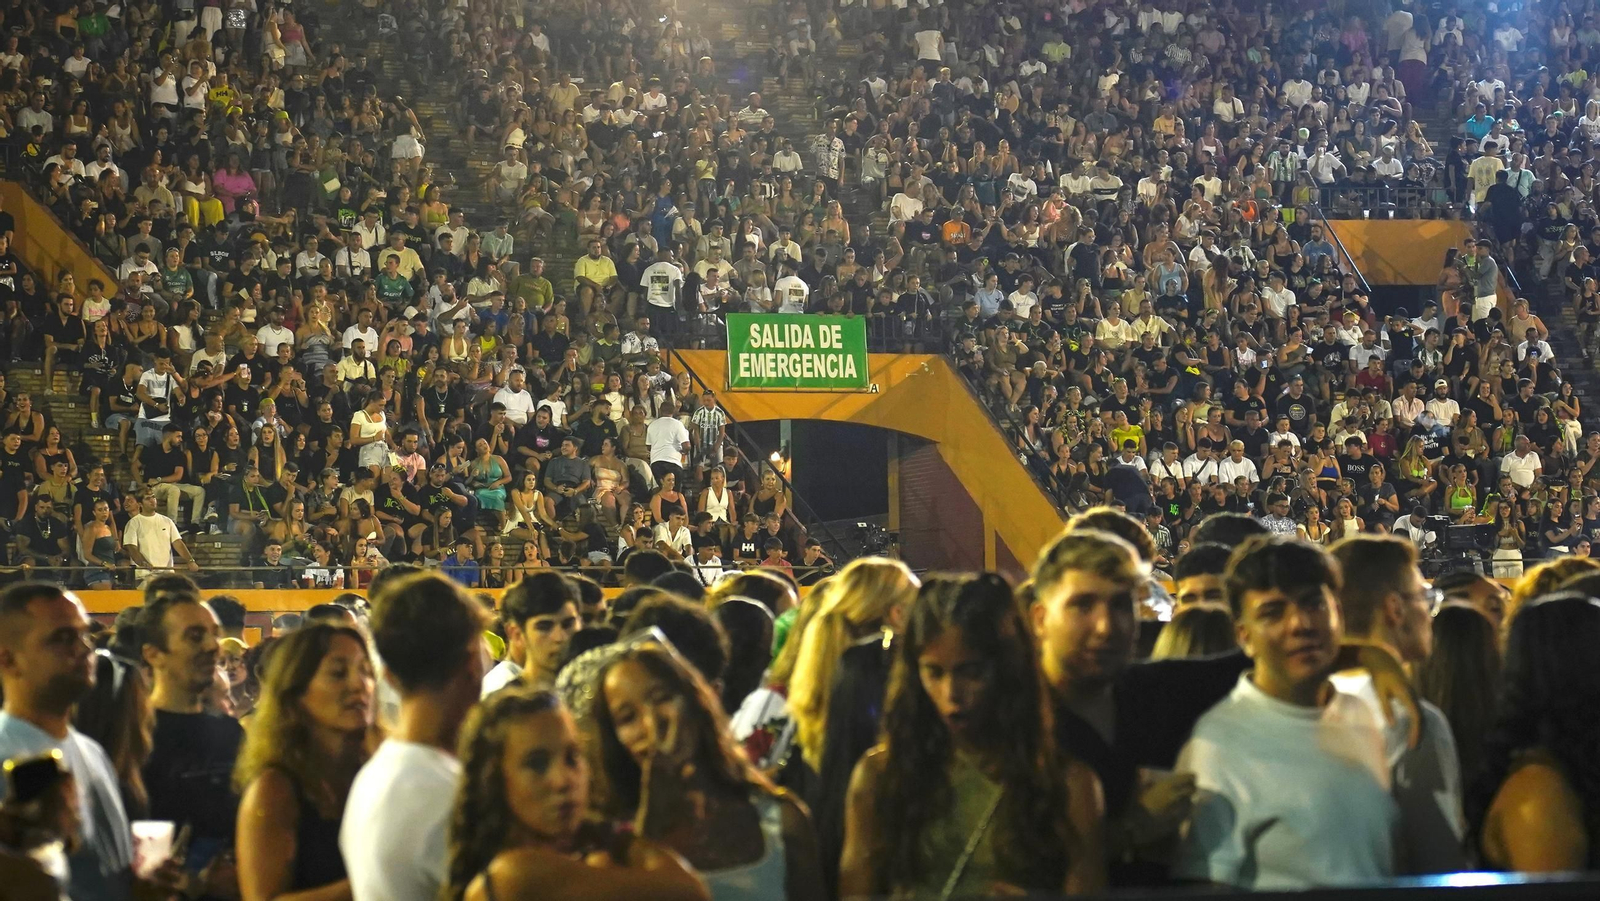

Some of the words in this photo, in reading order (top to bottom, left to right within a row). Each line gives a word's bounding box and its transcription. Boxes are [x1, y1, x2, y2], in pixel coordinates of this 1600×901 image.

[750, 323, 815, 348] SALIDA
[819, 324, 843, 348] DE
[739, 353, 857, 378] EMERGENCIA
[1347, 464, 1365, 472] BOSS
